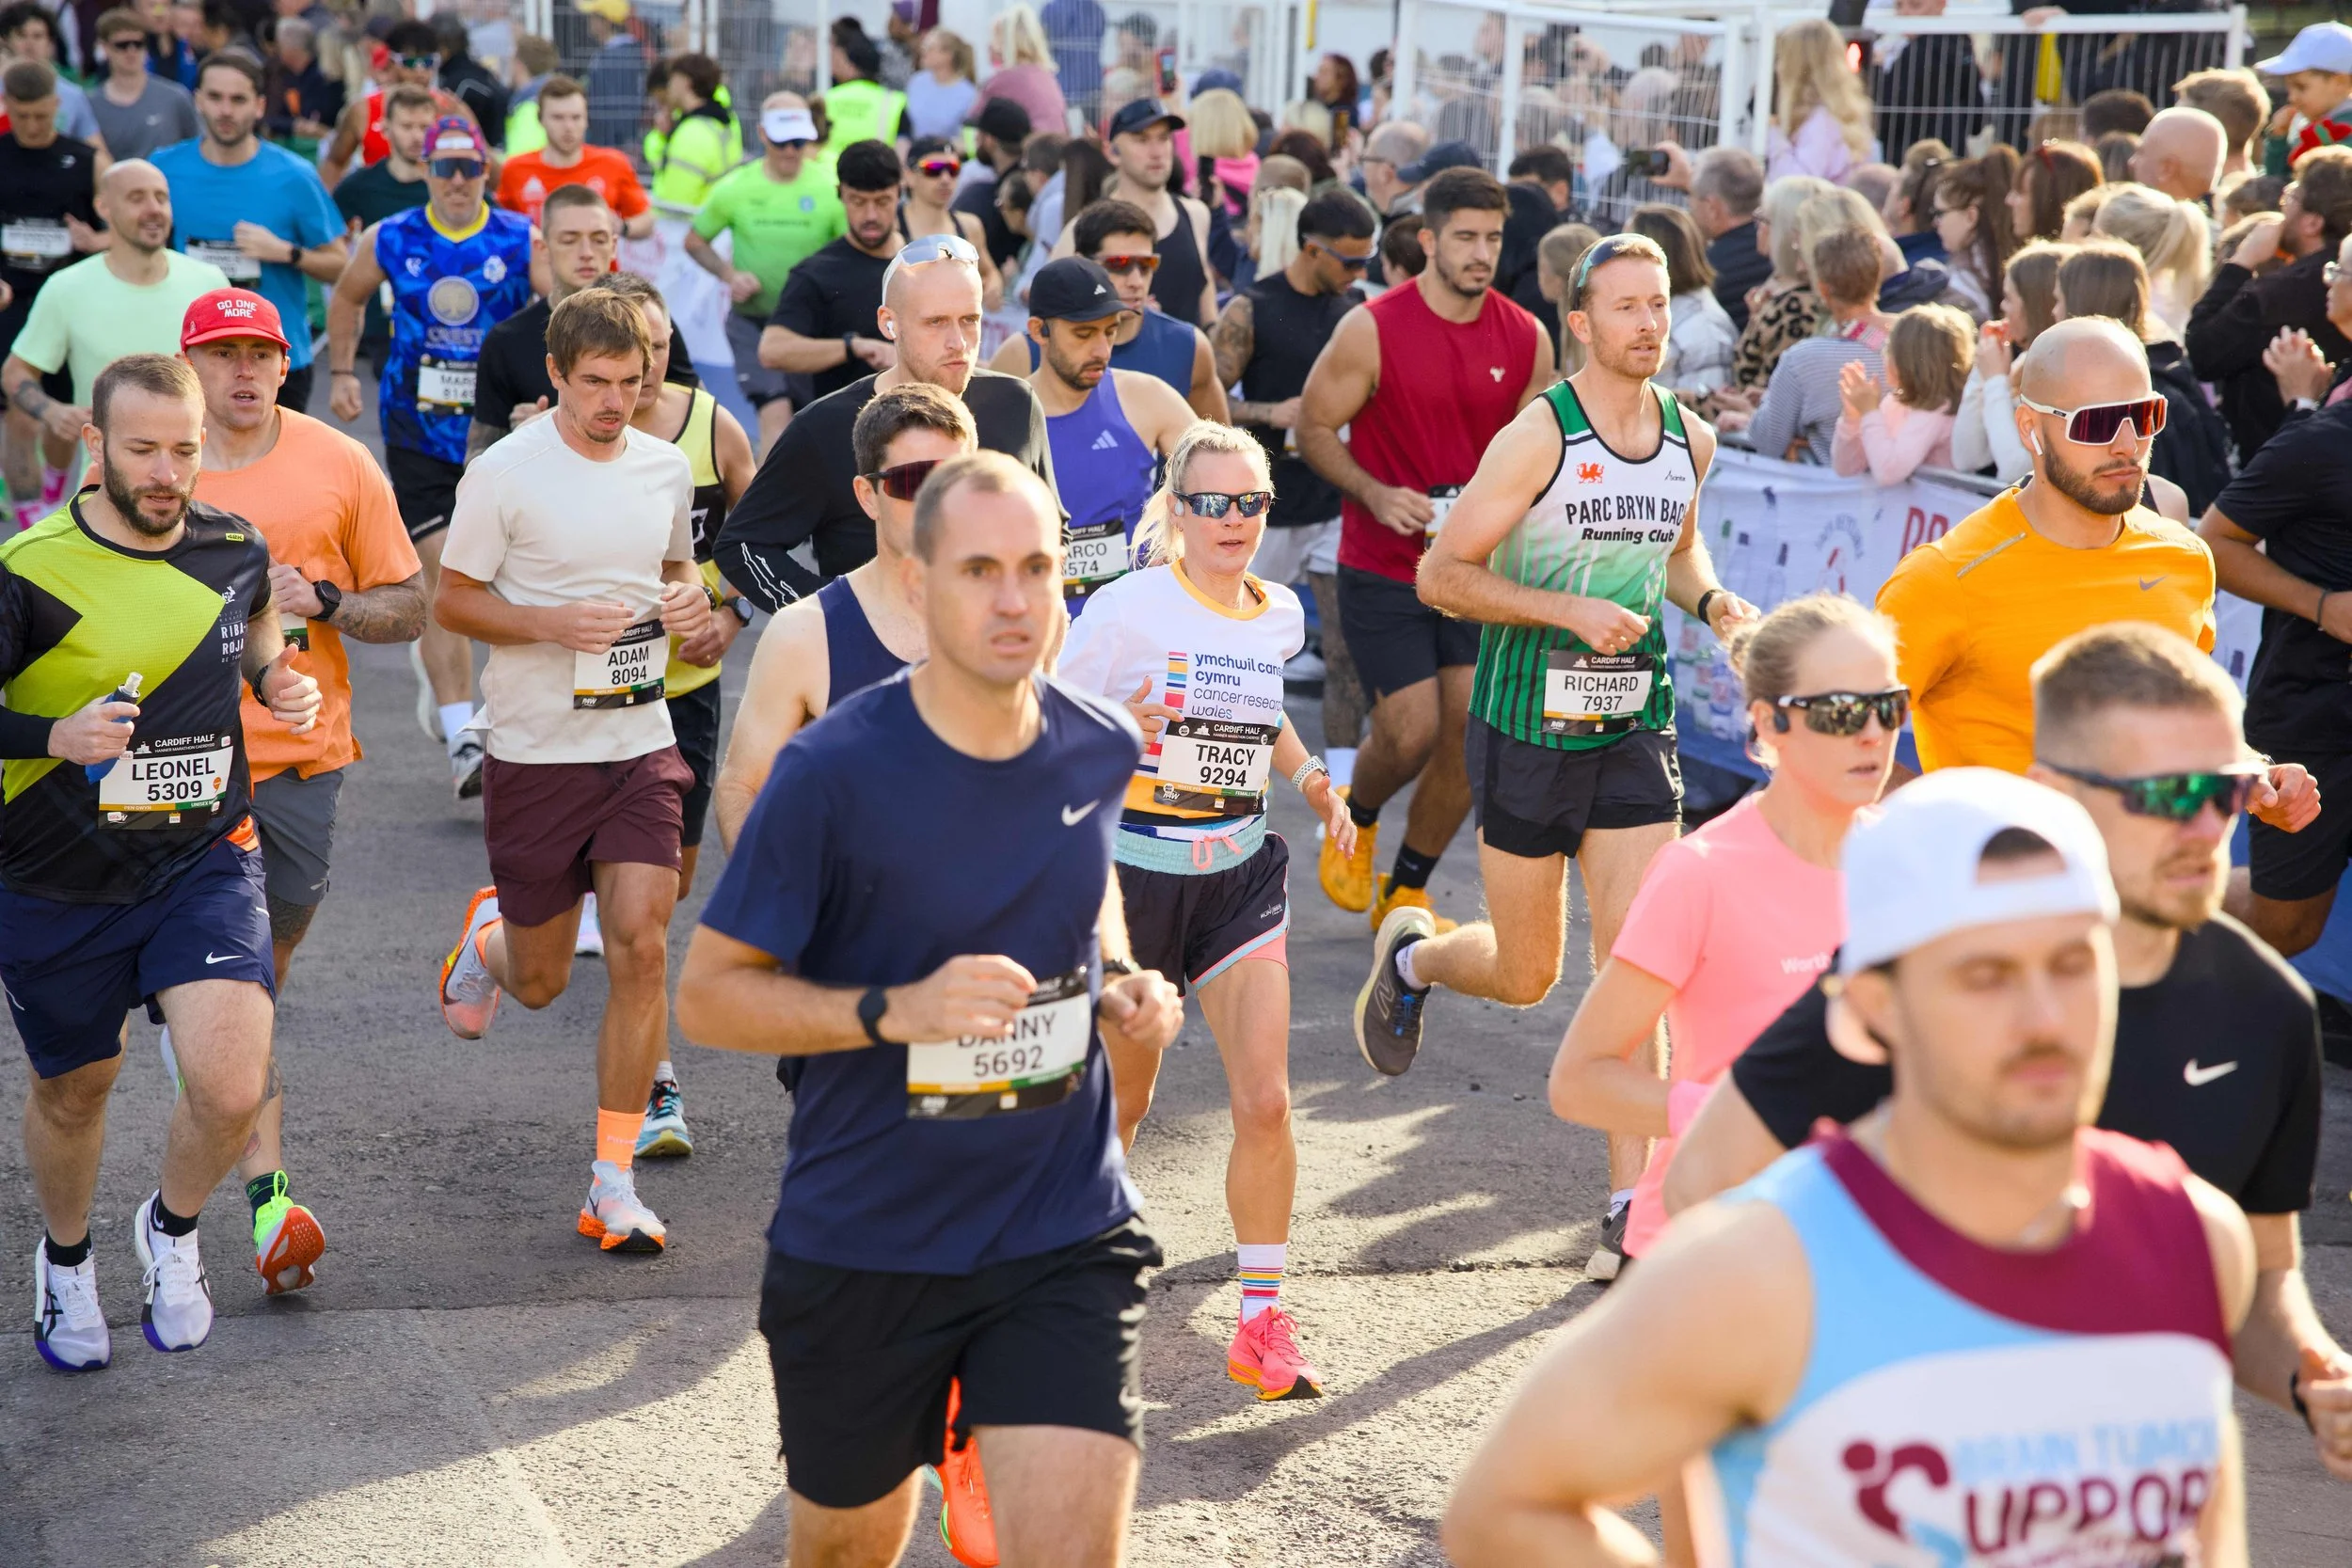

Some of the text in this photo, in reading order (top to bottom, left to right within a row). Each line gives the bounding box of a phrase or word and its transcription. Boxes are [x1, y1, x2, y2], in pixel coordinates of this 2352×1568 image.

[216, 300, 258, 311] GO ONE
[225, 309, 253, 318] MORE
[1565, 497, 1612, 525] PARC
[1616, 495, 1655, 520] BRYN
[1581, 528, 1675, 545] Running Club
[1064, 561, 1099, 576] 574
[621, 627, 641, 639] ARDIFF
[641, 625, 653, 634] HALF
[608, 645, 649, 667] ADAM
[1196, 653, 1256, 672] ymchwil
[612, 665, 647, 685] 8094
[1195, 671, 1241, 687] cymru
[1565, 675, 1639, 692] RICHARD
[1193, 688, 1245, 705] cancer
[1582, 696, 1623, 711] 7937
[1191, 705, 1233, 720] wales
[1214, 723, 1261, 735] CARDIFF HALF
[154, 734, 215, 748] CARDIFF HALF
[1196, 744, 1256, 766] TRACY
[132, 757, 215, 781] LEONEL
[1200, 766, 1247, 787] 9294
[147, 780, 202, 801] 5309
[974, 1046, 1043, 1076] 5692
